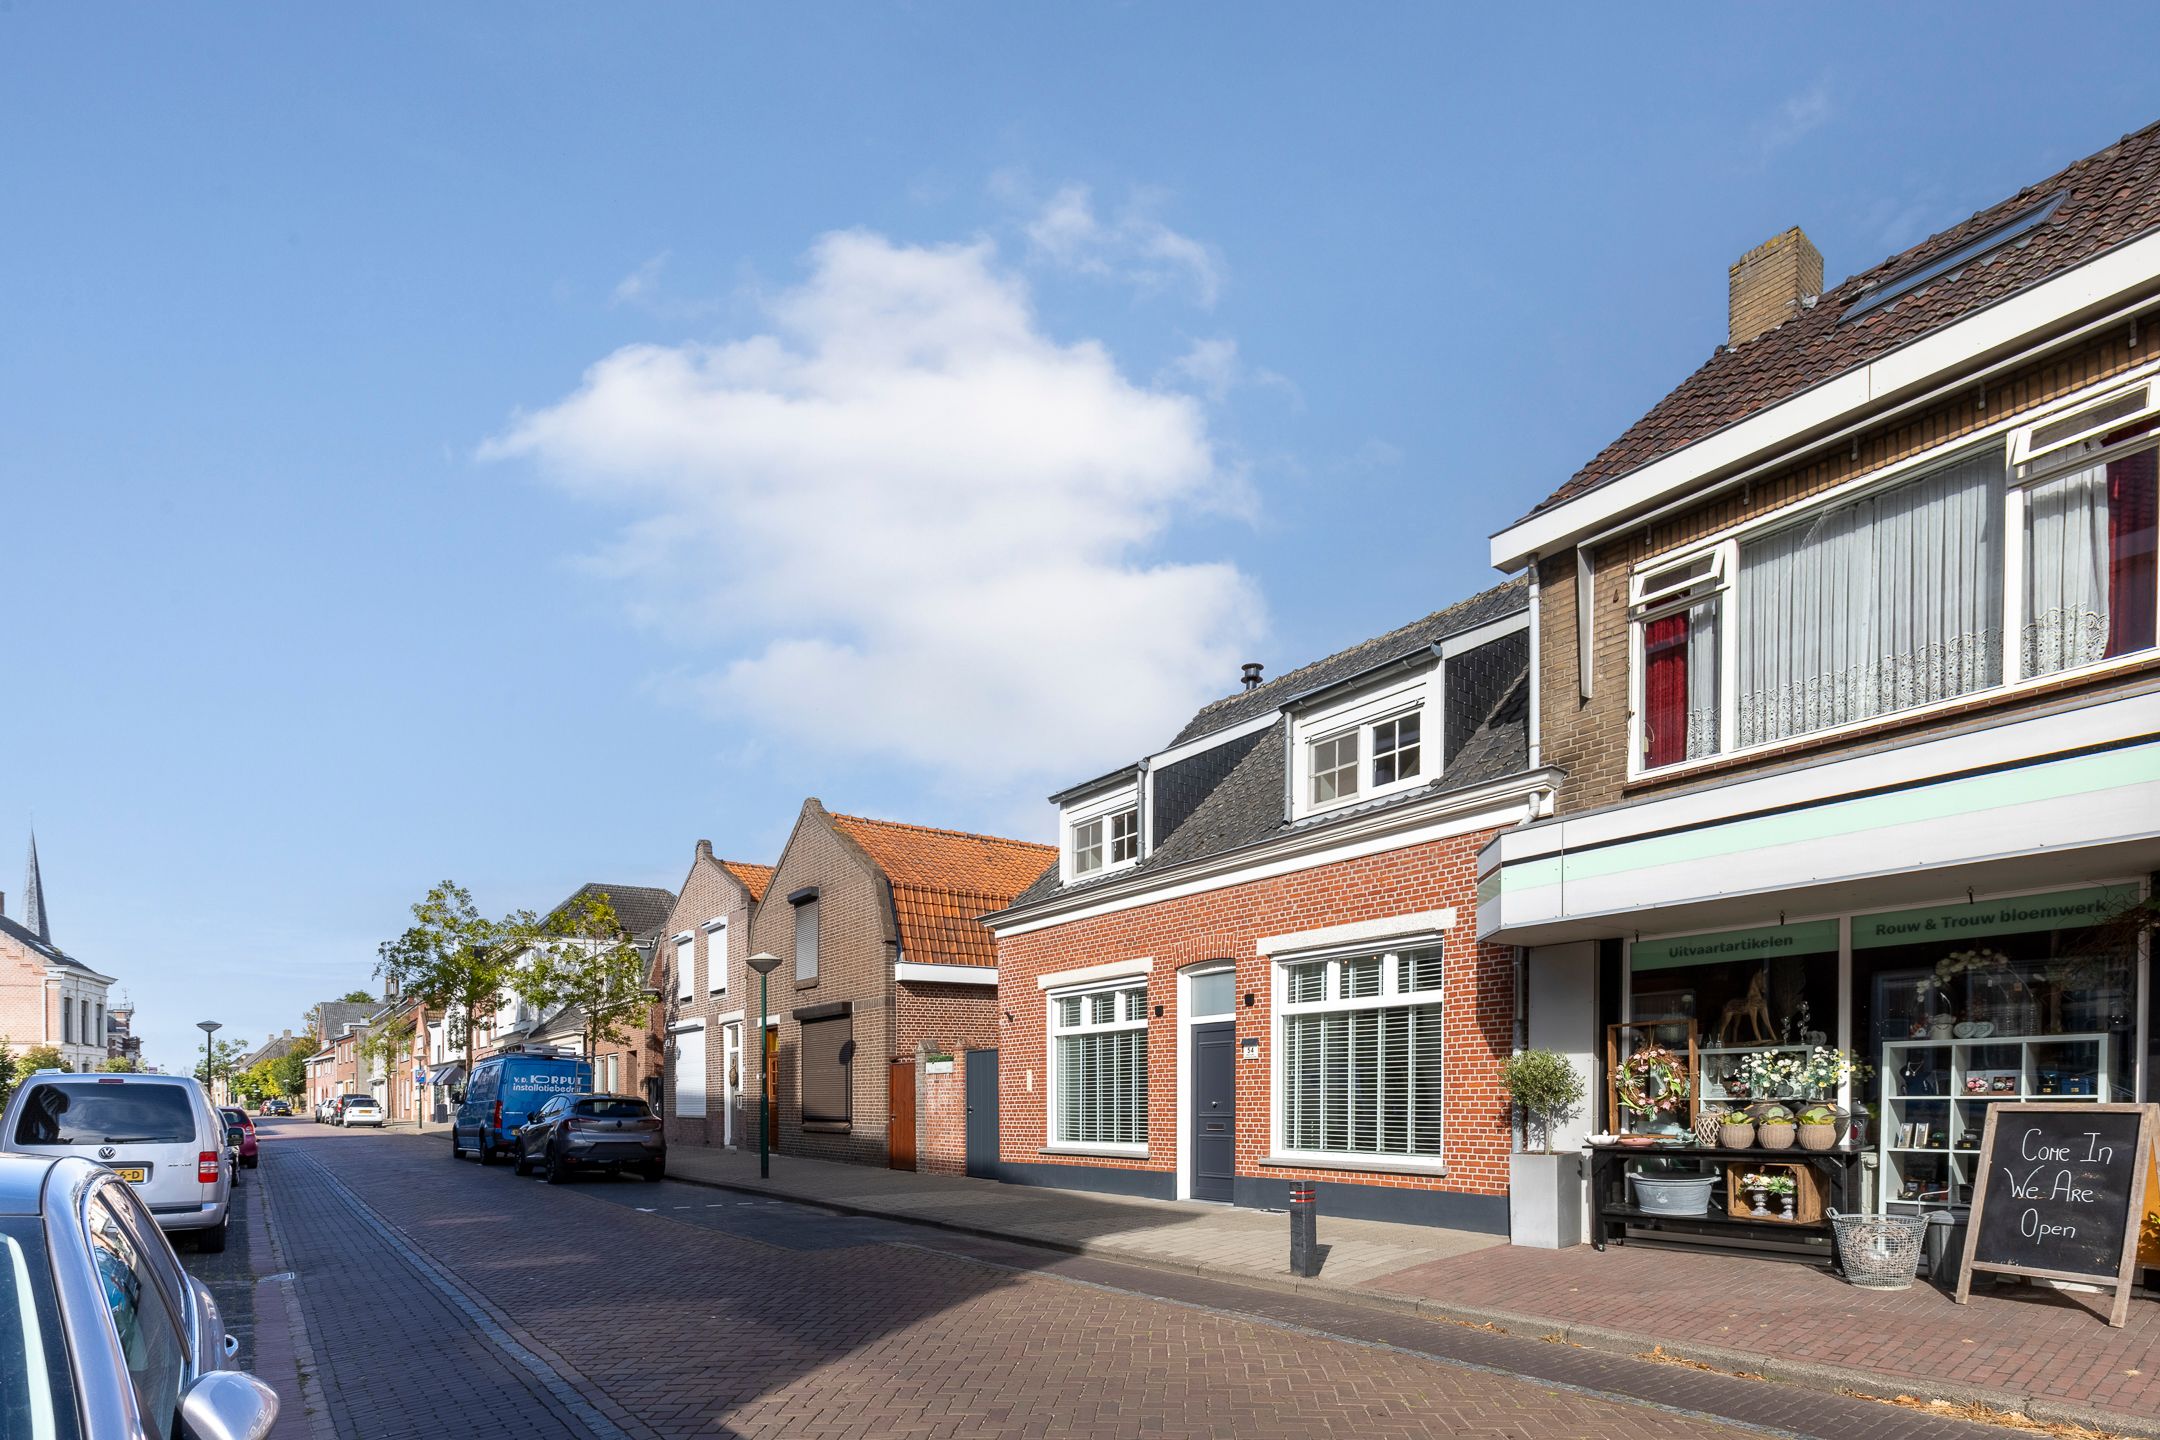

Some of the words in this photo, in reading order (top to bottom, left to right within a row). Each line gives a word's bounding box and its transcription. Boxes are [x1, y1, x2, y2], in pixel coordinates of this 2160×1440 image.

[1875, 919, 1921, 936] Rouw
[1924, 917, 1937, 931] &
[1941, 913, 1996, 929] Trouw
[2000, 899, 2107, 923] bloemwerk
[1668, 935, 1794, 958] Uitvaartartikelen
[512, 1082, 582, 1093] installatiebedrjf
[2080, 1132, 2113, 1165] In
[120, 1170, 140, 1180] 6-D
[2003, 1165, 2045, 1199] We
[2020, 1208, 2076, 1245] Open
